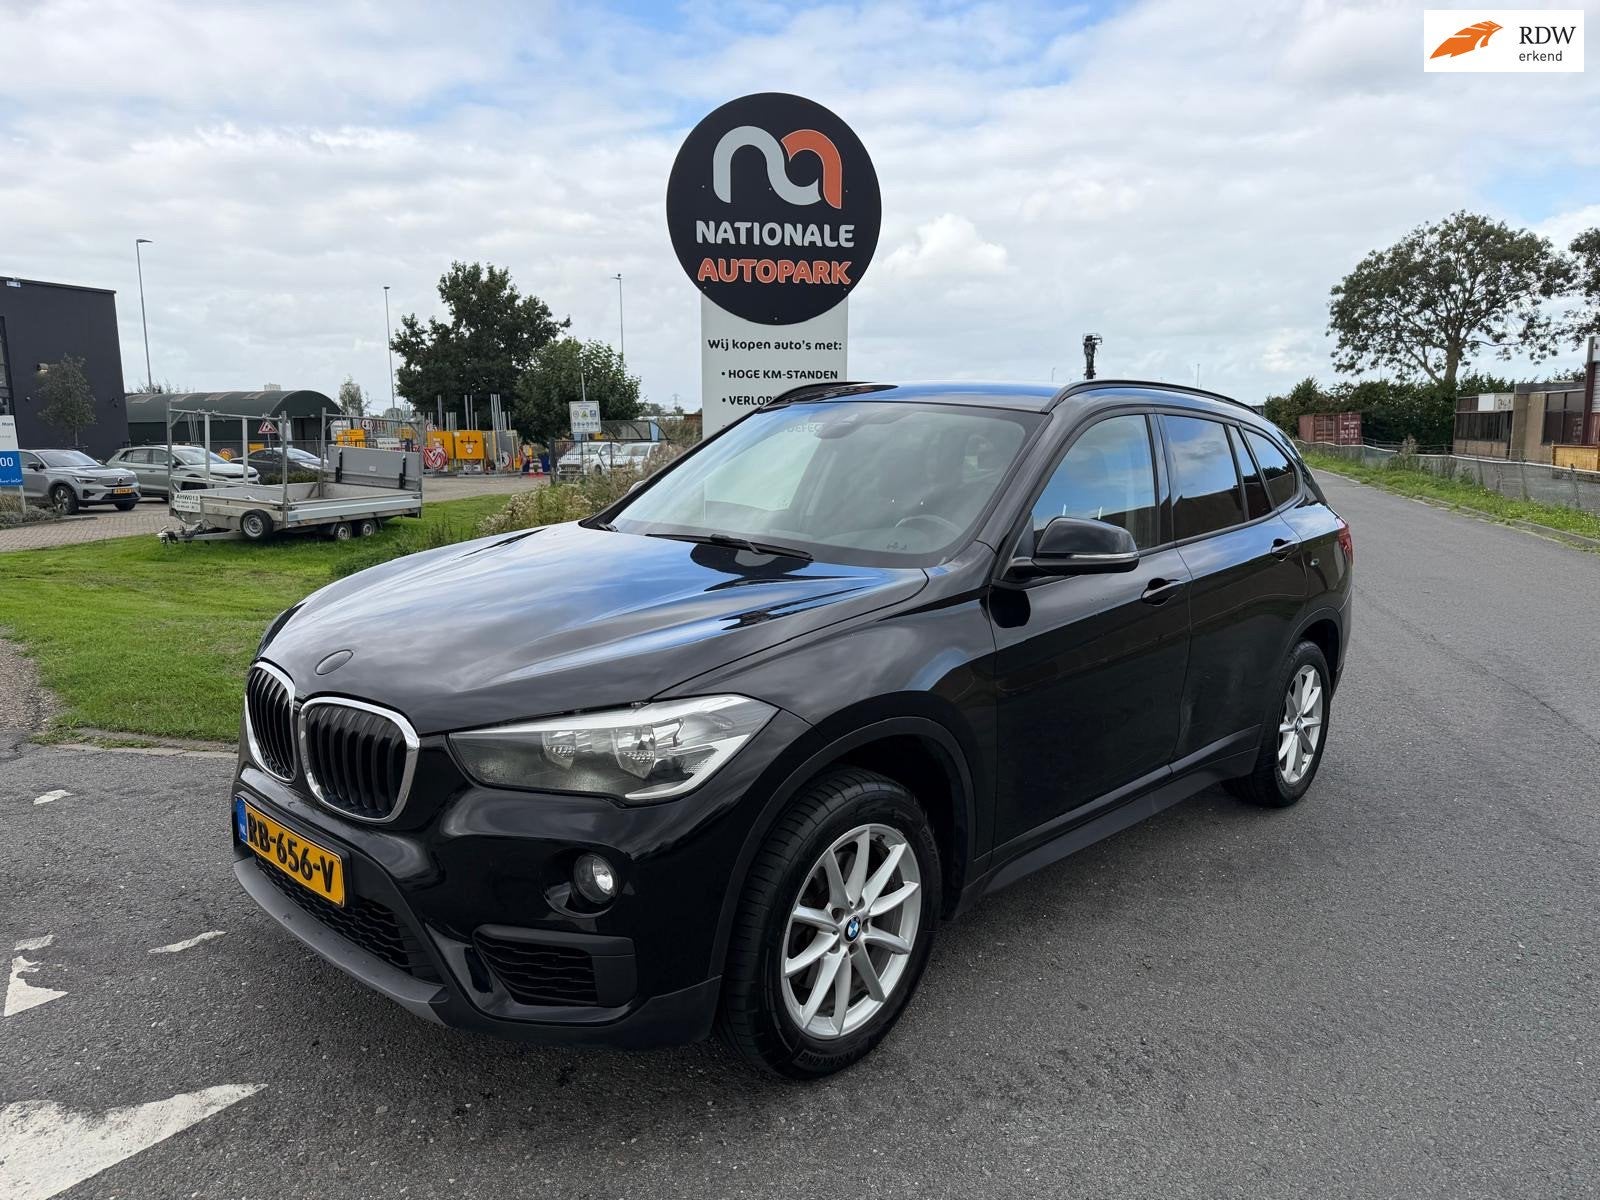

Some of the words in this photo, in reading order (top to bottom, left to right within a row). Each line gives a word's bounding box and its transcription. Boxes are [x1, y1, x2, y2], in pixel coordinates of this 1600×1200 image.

[695, 220, 855, 248] NATIONALE
[697, 257, 852, 285] AUTOPARK
[708, 339, 729, 351] Wij
[732, 340, 771, 351] kopen
[774, 340, 812, 350] auto's
[814, 341, 843, 350] met:
[728, 369, 761, 379] HOGE
[763, 370, 838, 379] KM-STANDEN
[729, 395, 776, 405] VERLOP
[247, 812, 334, 893] RB-656-V
